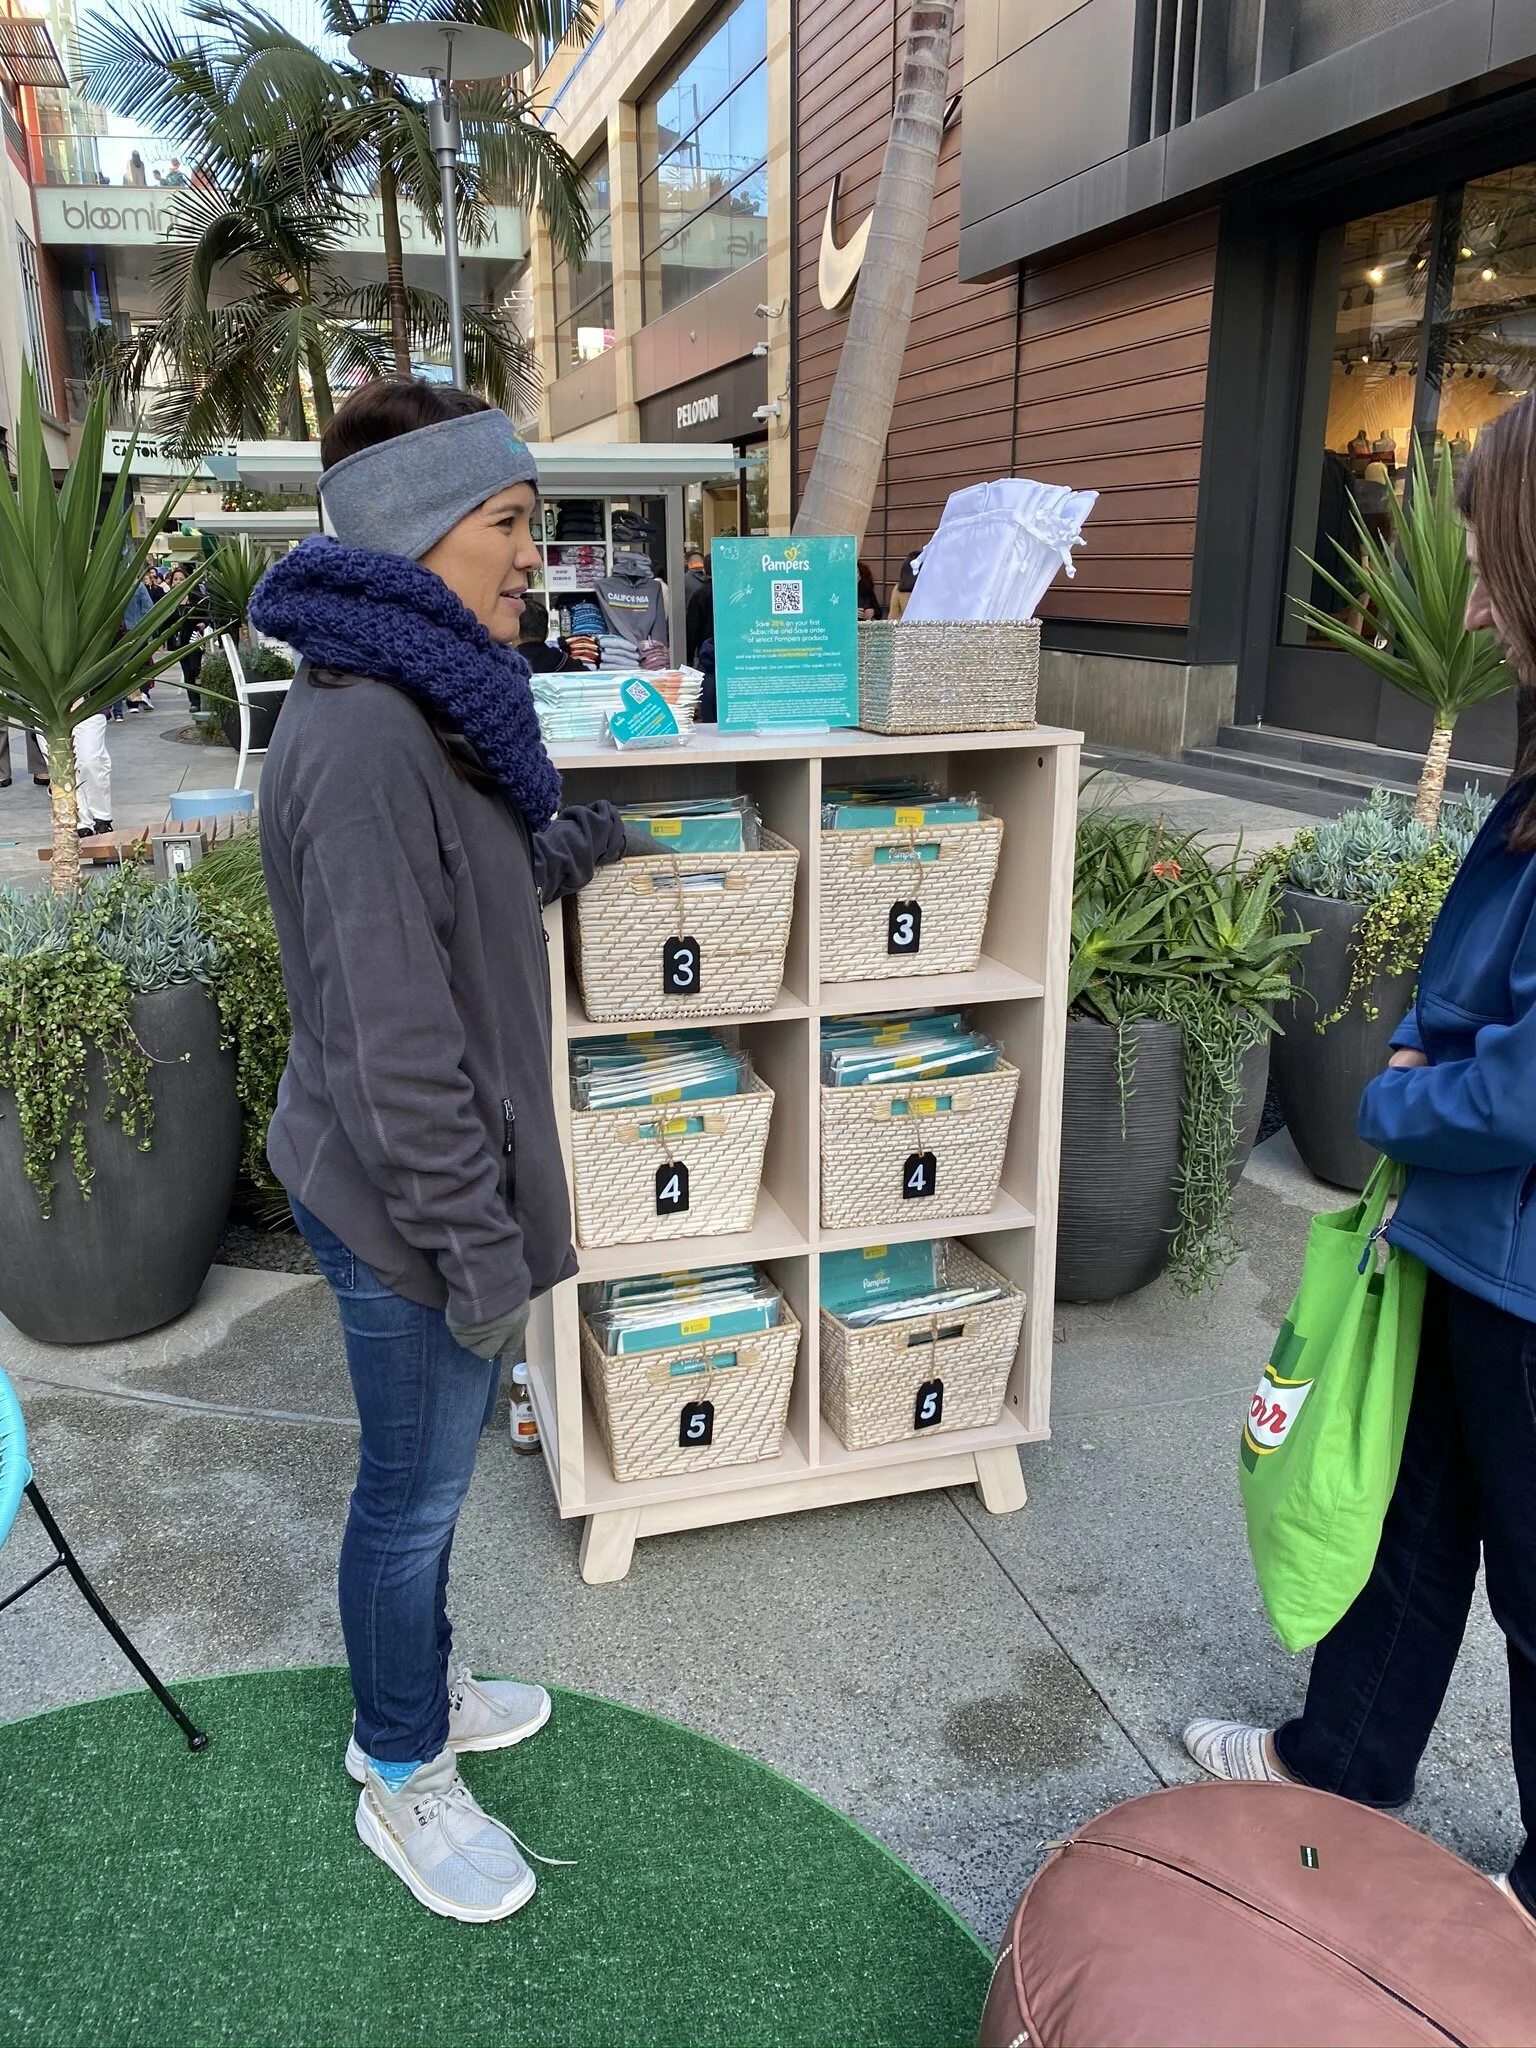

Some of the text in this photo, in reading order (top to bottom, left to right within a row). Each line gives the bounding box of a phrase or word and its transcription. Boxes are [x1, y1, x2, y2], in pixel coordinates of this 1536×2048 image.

[677, 394, 719, 429] PELOTON
[112, 445, 158, 458] CATON
[761, 554, 811, 573] Pampers
[774, 635, 800, 643] Pampers
[801, 634, 829, 642] products
[892, 913, 914, 945] 3
[673, 949, 694, 986] 3
[659, 1174, 681, 1203] 4
[907, 1163, 927, 1191] 4
[863, 1277, 891, 1289] Pampers
[920, 1392, 938, 1420] 5
[686, 1413, 706, 1438] 5
